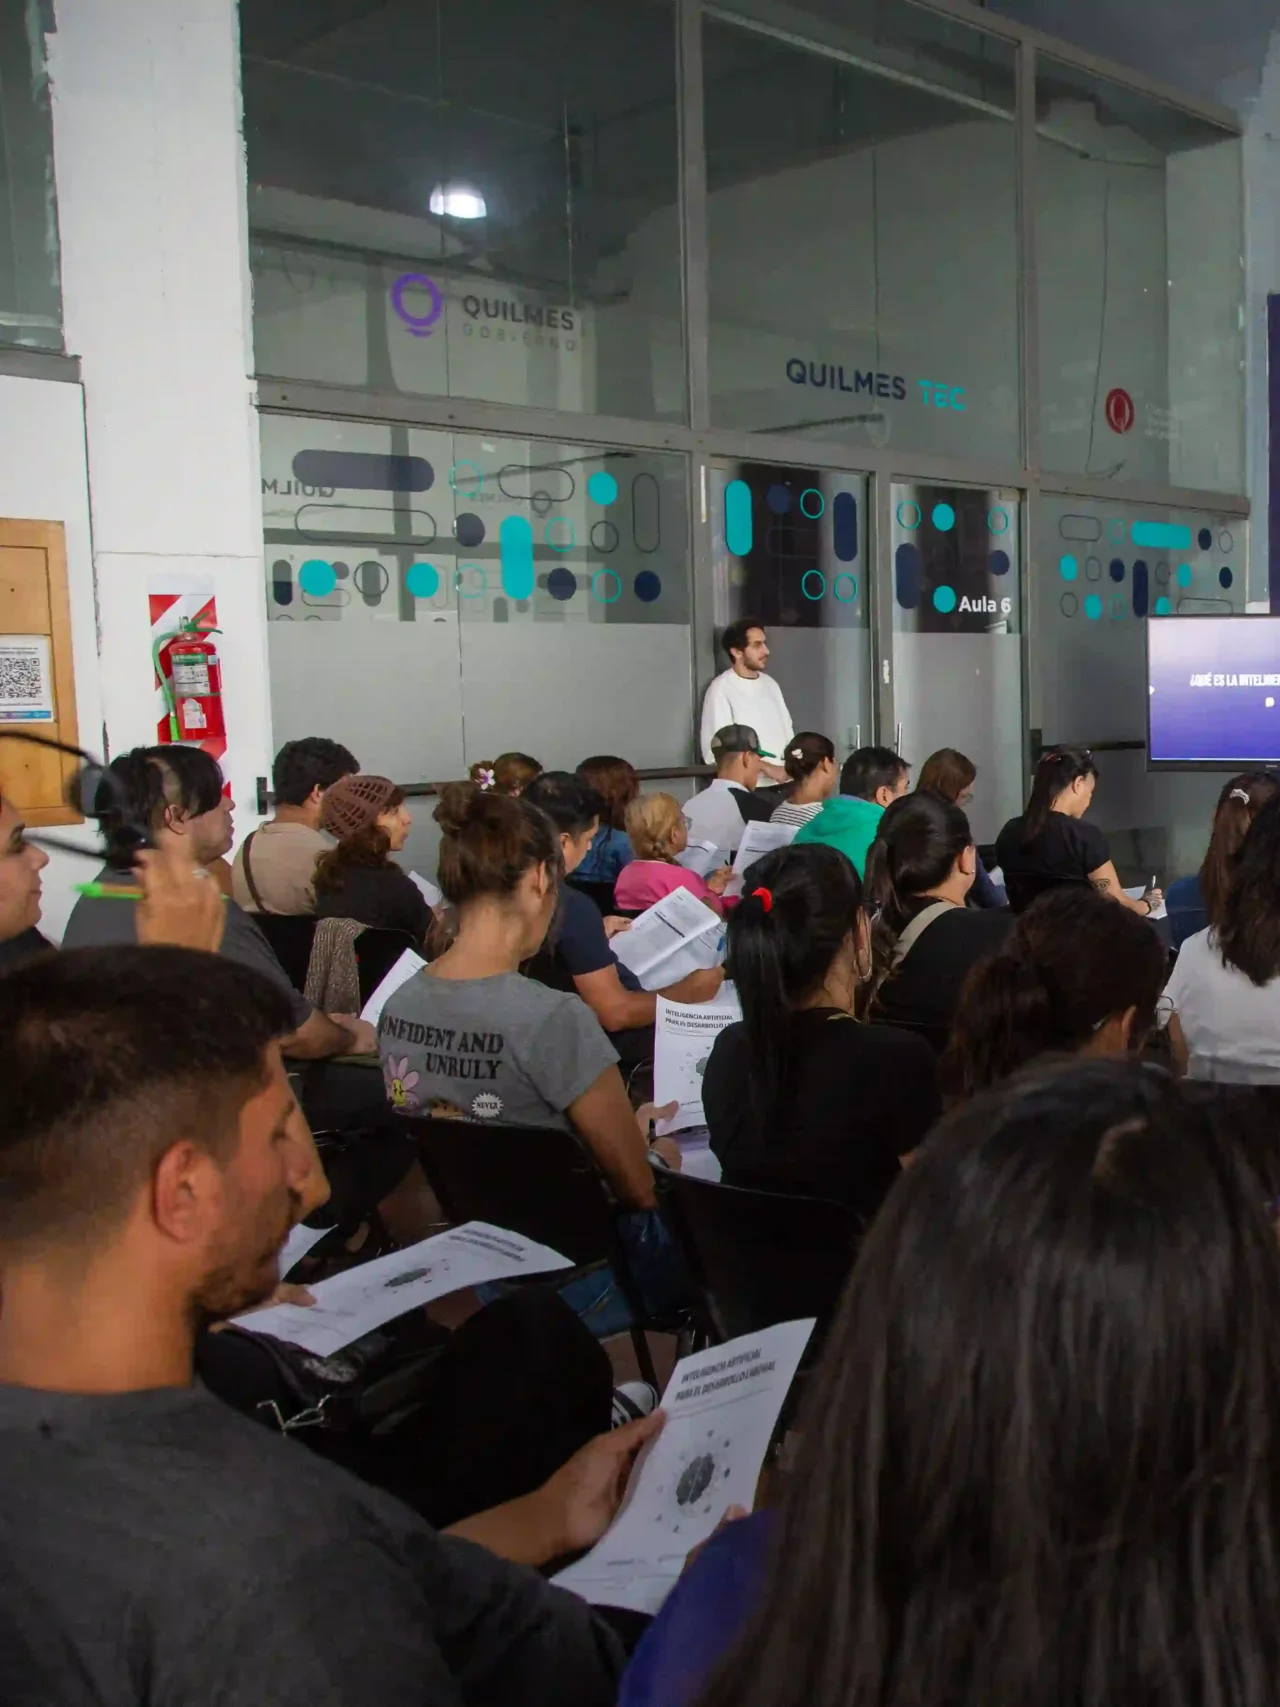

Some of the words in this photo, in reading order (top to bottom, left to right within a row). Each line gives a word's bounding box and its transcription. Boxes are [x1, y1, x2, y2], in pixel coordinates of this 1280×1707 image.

[462, 294, 574, 330] QUILMES
[786, 357, 906, 401] QUILMES
[918, 379, 966, 412] TEC
[958, 595, 997, 613] Aula
[1000, 597, 1012, 614] 6
[1213, 674, 1225, 687] ES
[1226, 674, 1239, 687] LA
[458, 1032, 504, 1054] AND
[426, 1052, 502, 1080] UNRULY
[476, 1101, 498, 1110] NEVER
